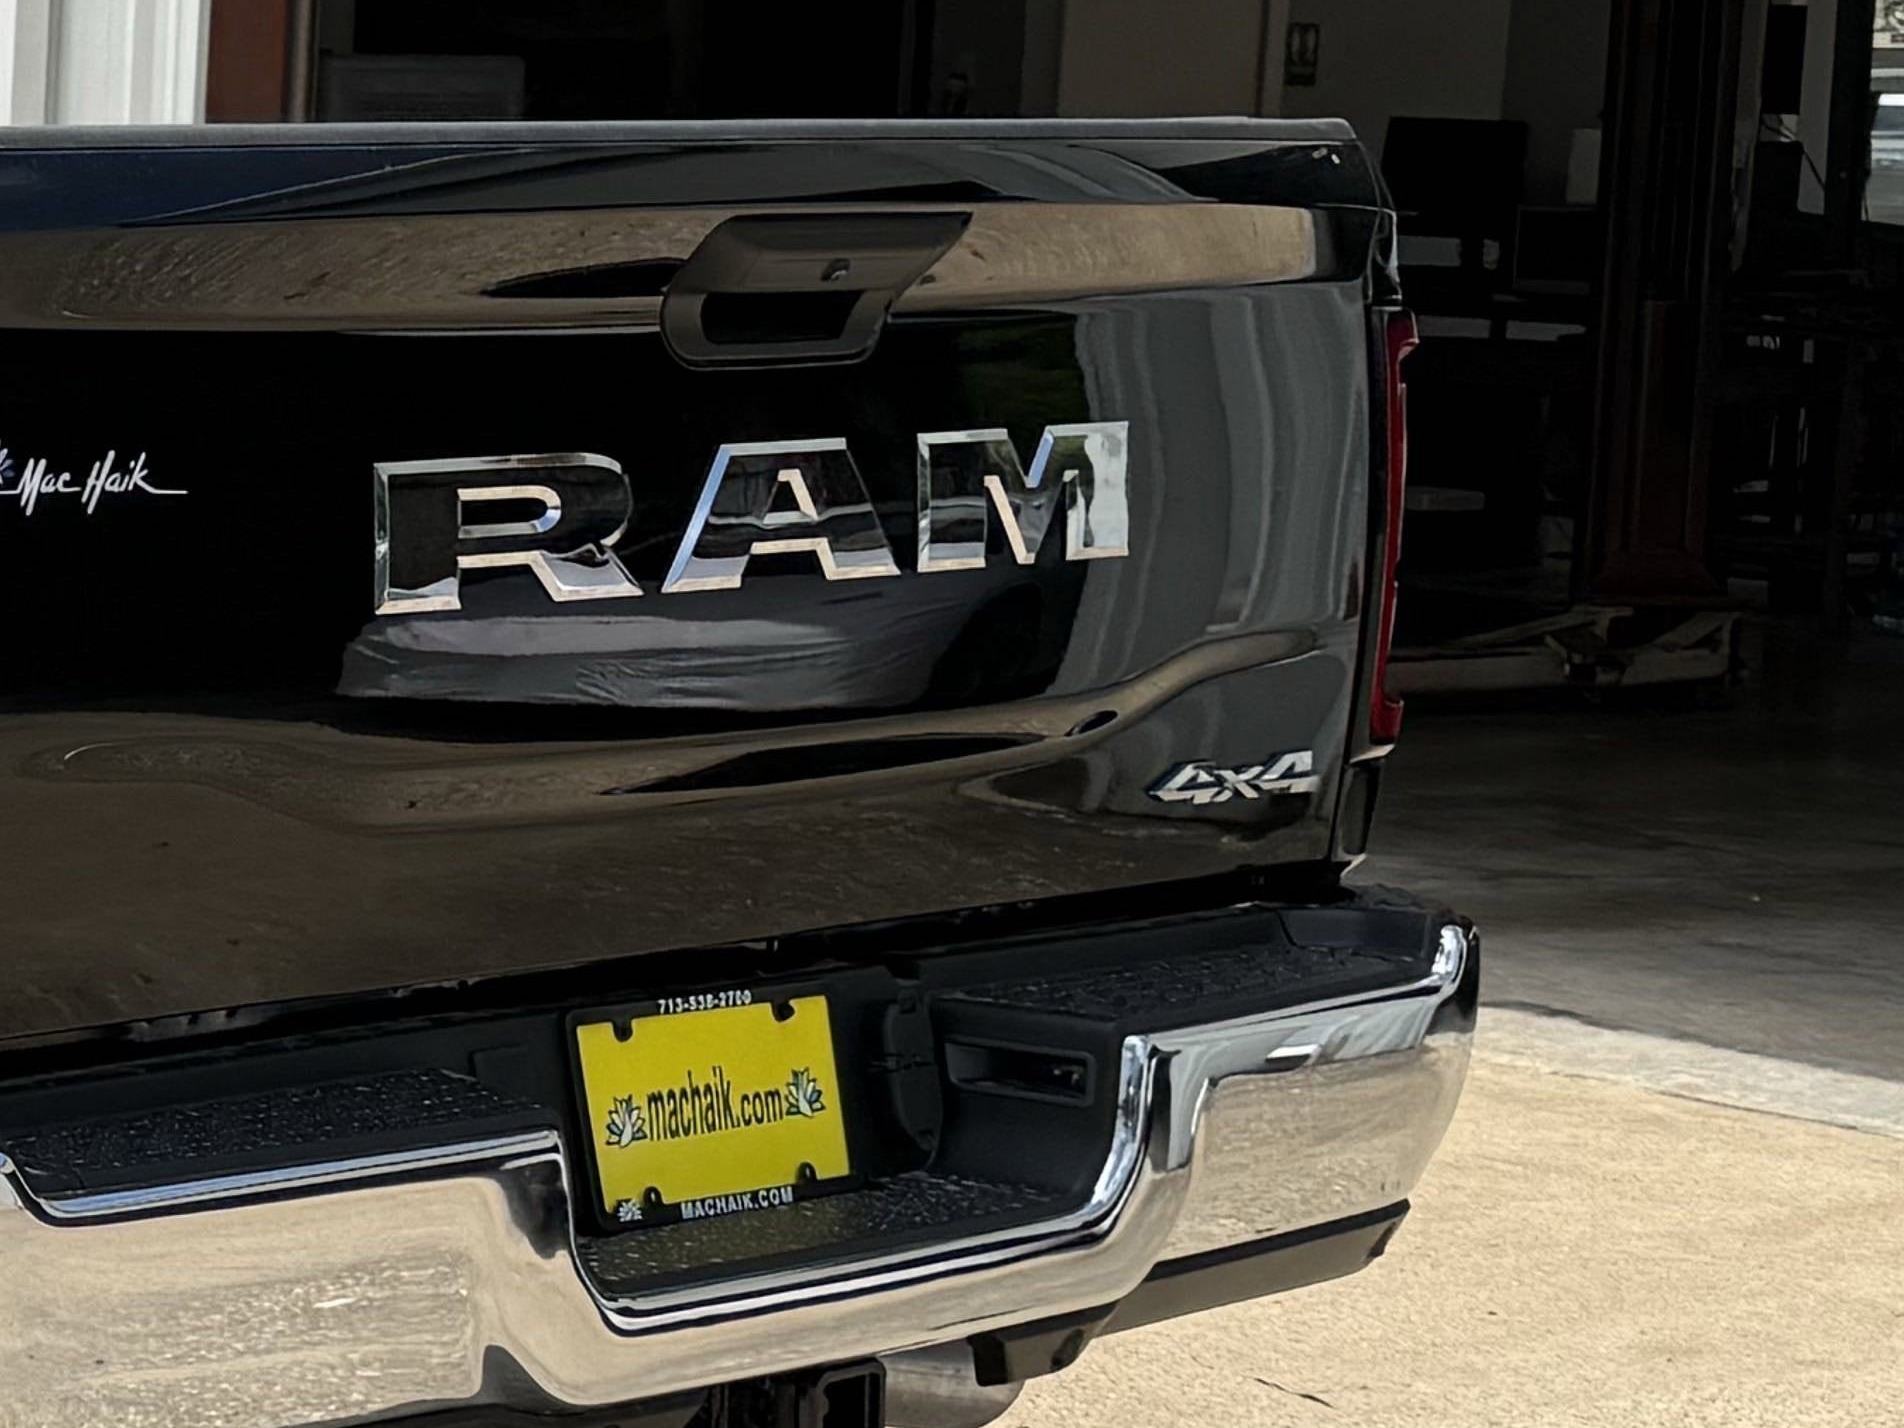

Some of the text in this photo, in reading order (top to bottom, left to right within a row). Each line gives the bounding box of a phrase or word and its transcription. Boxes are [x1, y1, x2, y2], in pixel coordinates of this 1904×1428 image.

[81, 449, 189, 515] Haik
[373, 420, 1130, 615] RAM
[646, 1065, 784, 1142] machaik.com
[680, 1186, 794, 1220] MACHAIK.COM
